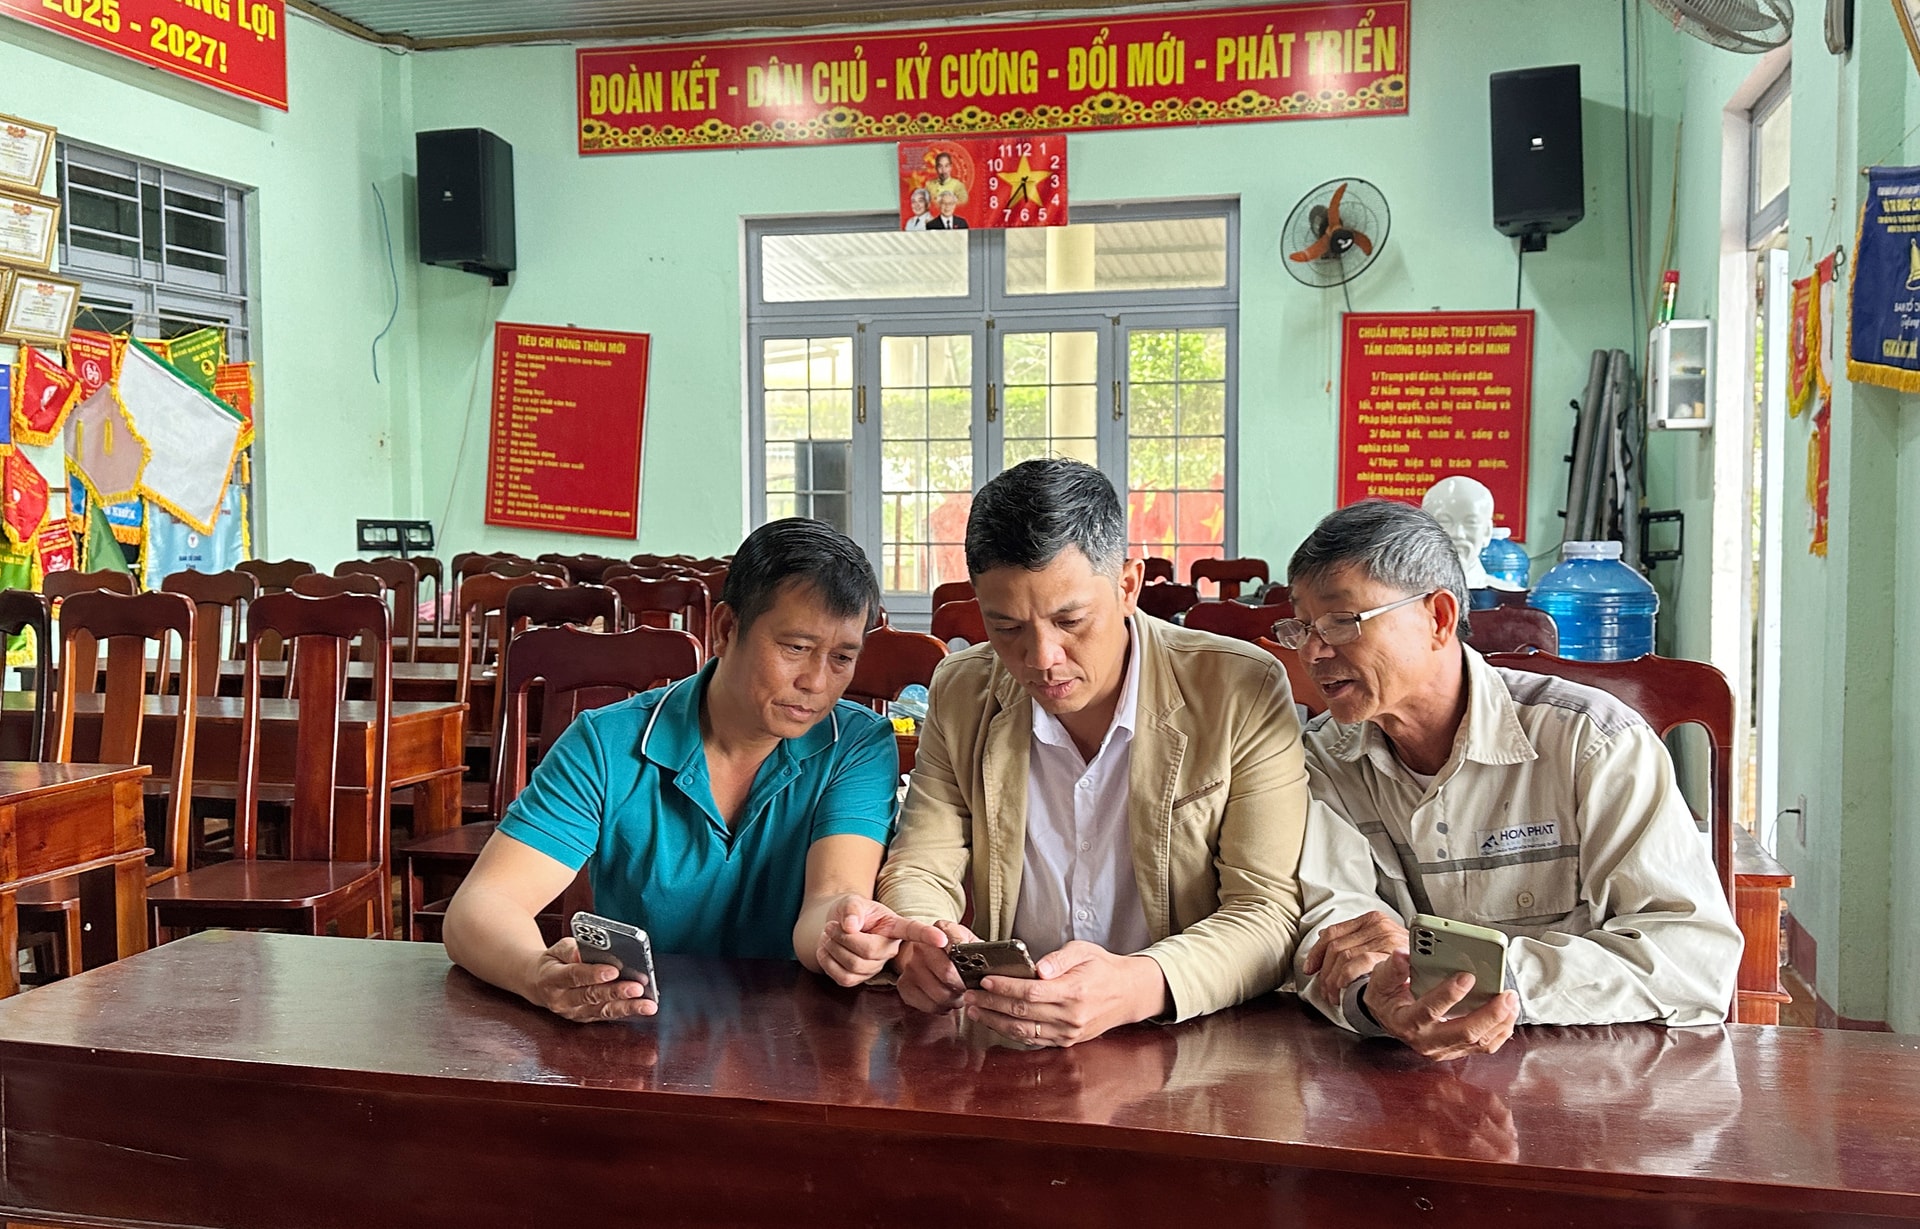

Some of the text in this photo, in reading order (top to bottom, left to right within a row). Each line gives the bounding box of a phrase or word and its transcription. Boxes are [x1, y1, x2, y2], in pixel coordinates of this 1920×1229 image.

[238, 0, 276, 42] LỢI
[150, 16, 228, 73] 2027!
[589, 9, 1396, 115] ĐOÀN KẾT - DÂN CHỦ - KỶ CƯƠNG - ĐỔI MỚI - PHÁT TRIỂN
[998, 144, 1012, 157] 11
[1016, 143, 1032, 156] 12
[1040, 142, 1046, 155] 1
[987, 159, 1003, 172] 10
[1051, 156, 1059, 169] 2
[989, 177, 998, 190] 9
[1051, 175, 1059, 188] 3
[990, 196, 998, 209] 8
[1051, 193, 1059, 206] 4
[1003, 209, 1012, 222] 7
[1020, 208, 1029, 221] 6
[1038, 208, 1047, 221] 5
